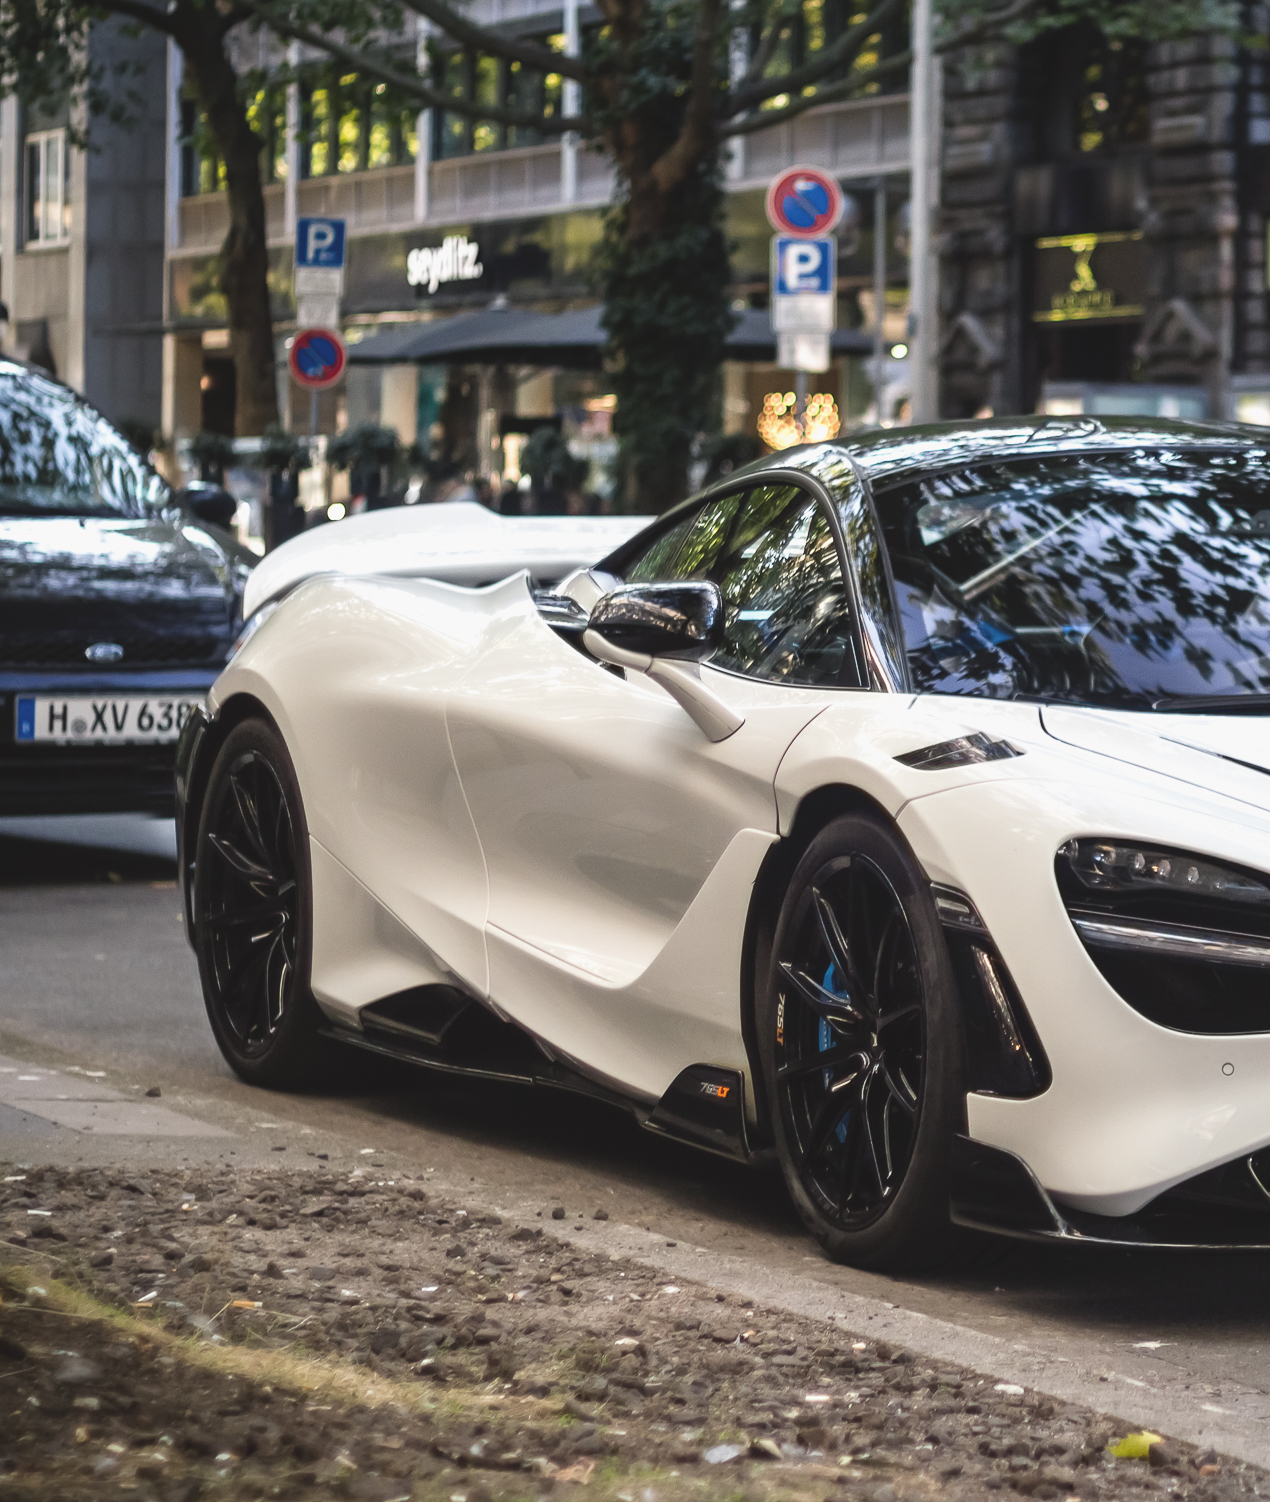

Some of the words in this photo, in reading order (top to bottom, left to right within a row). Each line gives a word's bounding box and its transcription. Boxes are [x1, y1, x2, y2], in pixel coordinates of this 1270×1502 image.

[307, 224, 335, 264] P
[786, 242, 822, 291] P
[48, 703, 68, 733] H
[91, 703, 129, 733] XV
